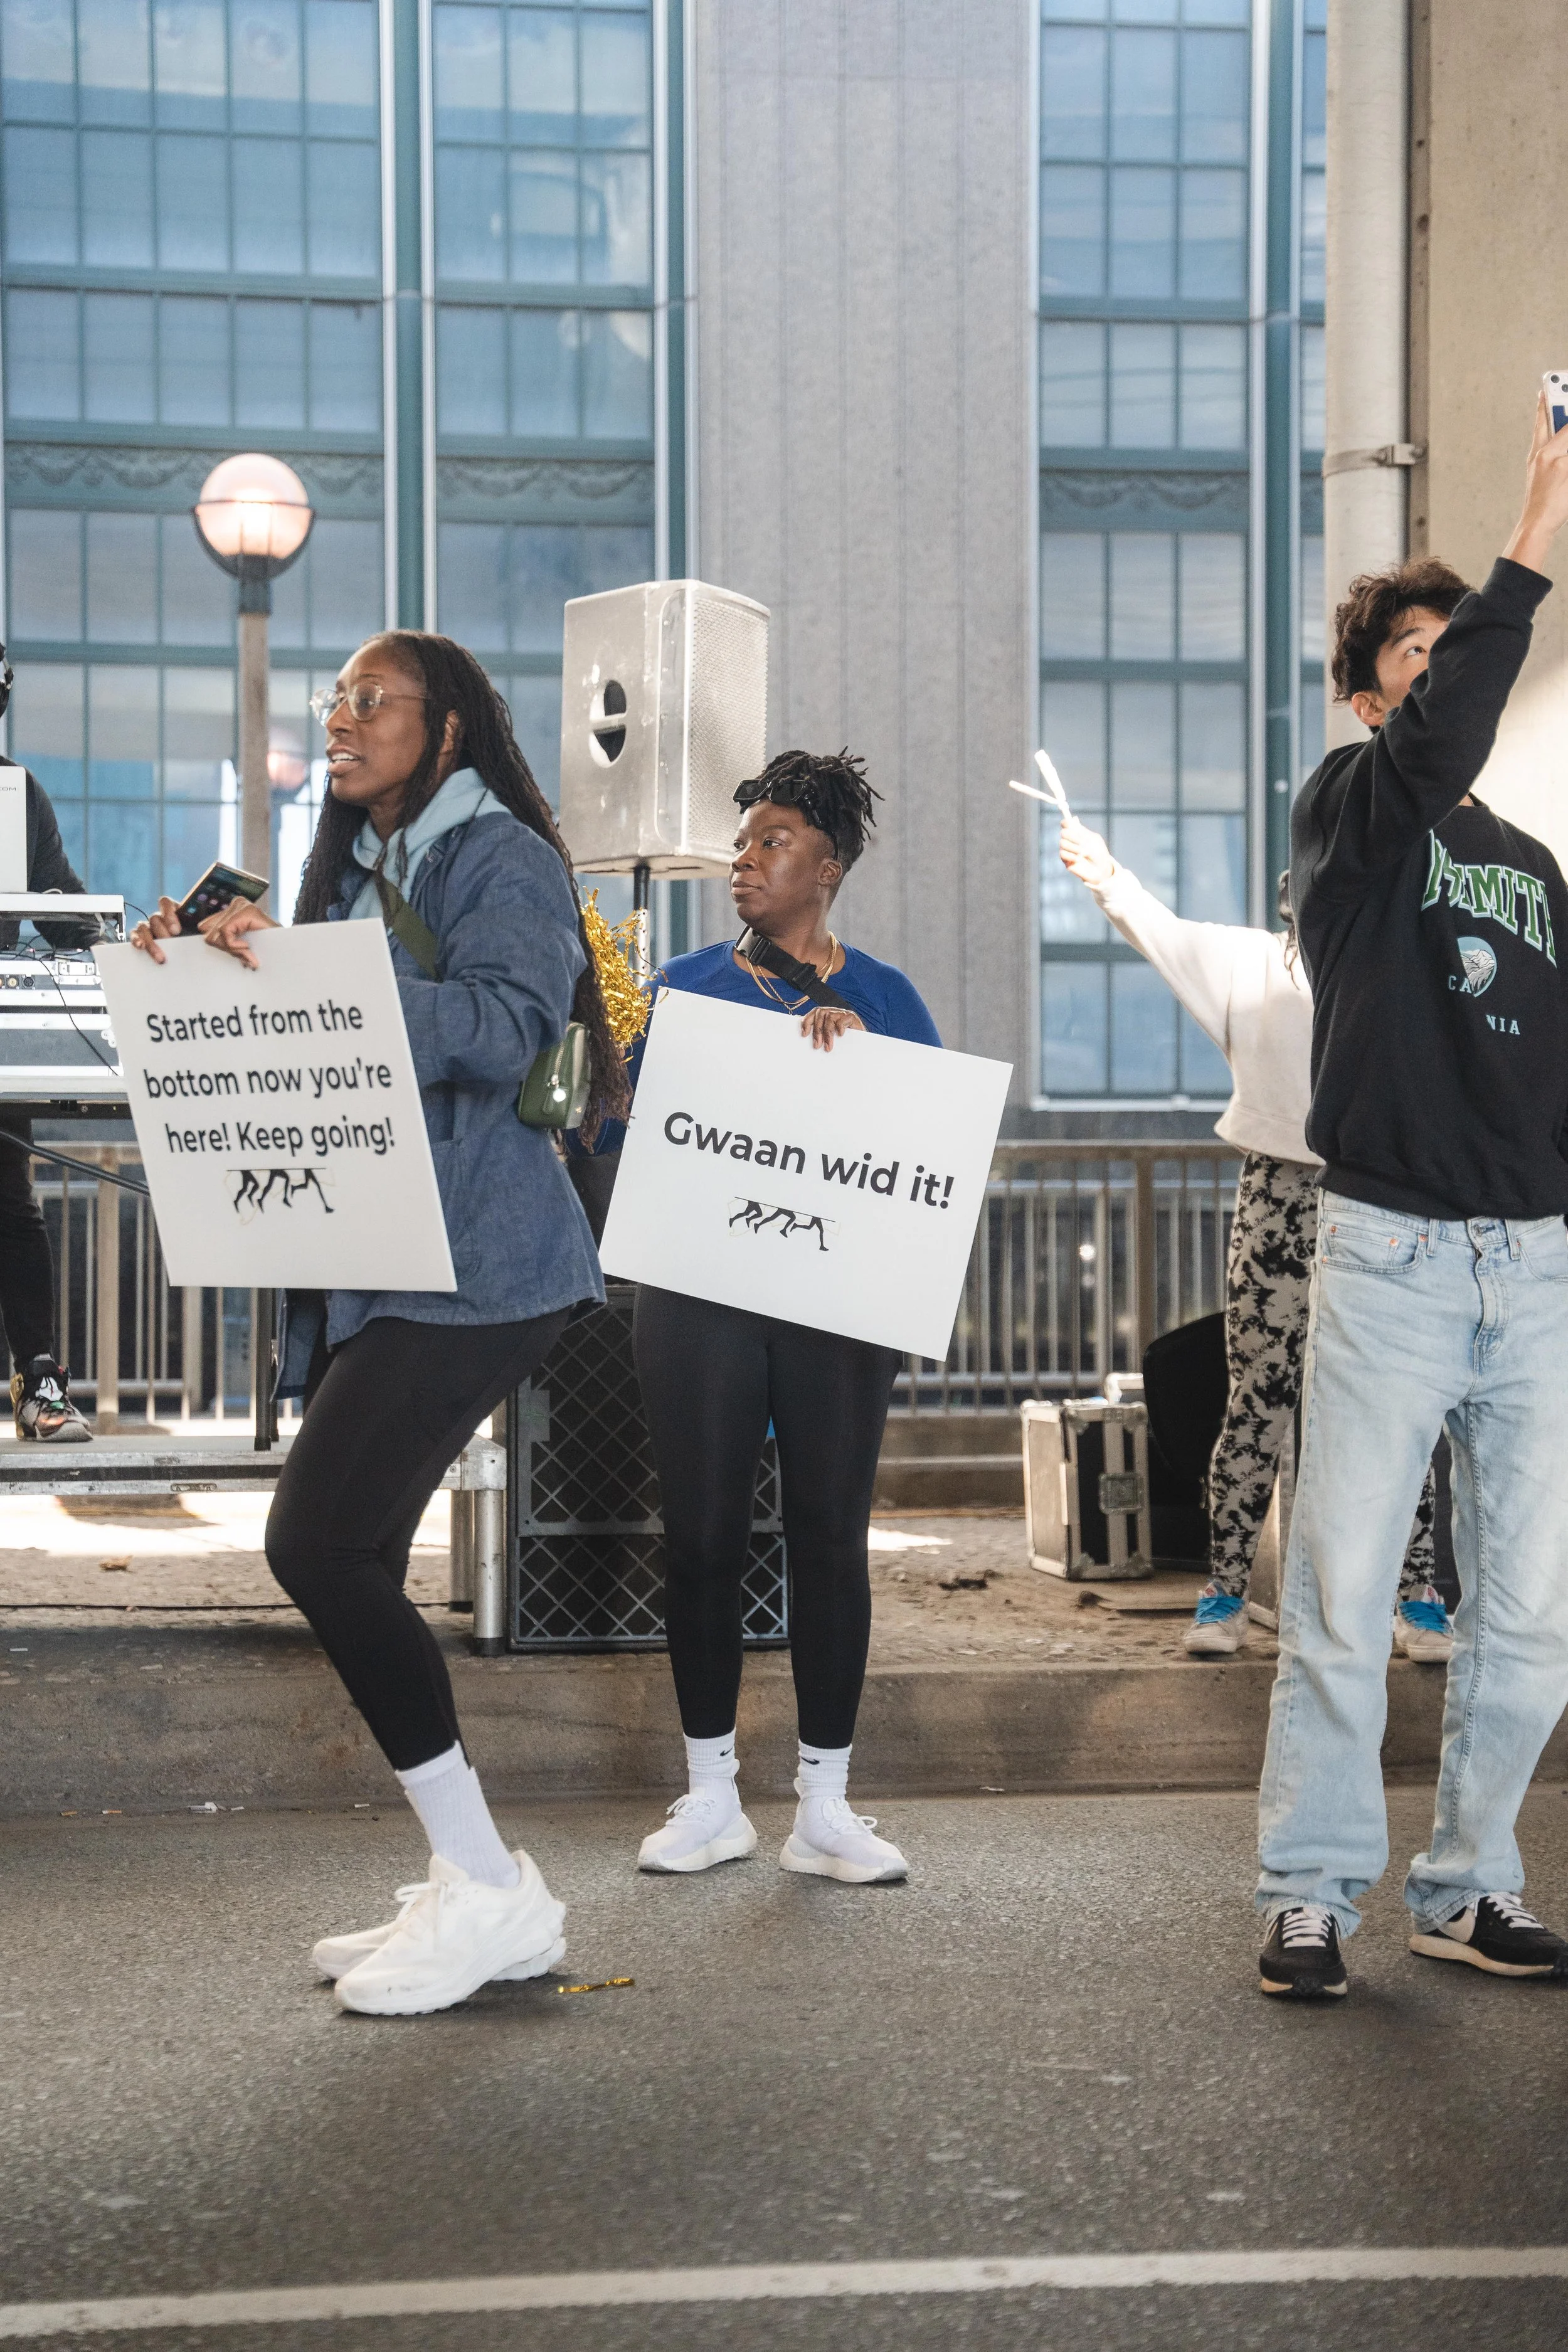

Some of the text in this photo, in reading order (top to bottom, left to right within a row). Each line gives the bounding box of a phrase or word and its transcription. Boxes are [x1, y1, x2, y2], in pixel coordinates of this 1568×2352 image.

[146, 999, 363, 1043] Started from the
[143, 1057, 392, 1099] bottom now you're
[164, 1115, 396, 1158] here! Keep going!
[664, 1111, 955, 1210] Gwaan wid it!
